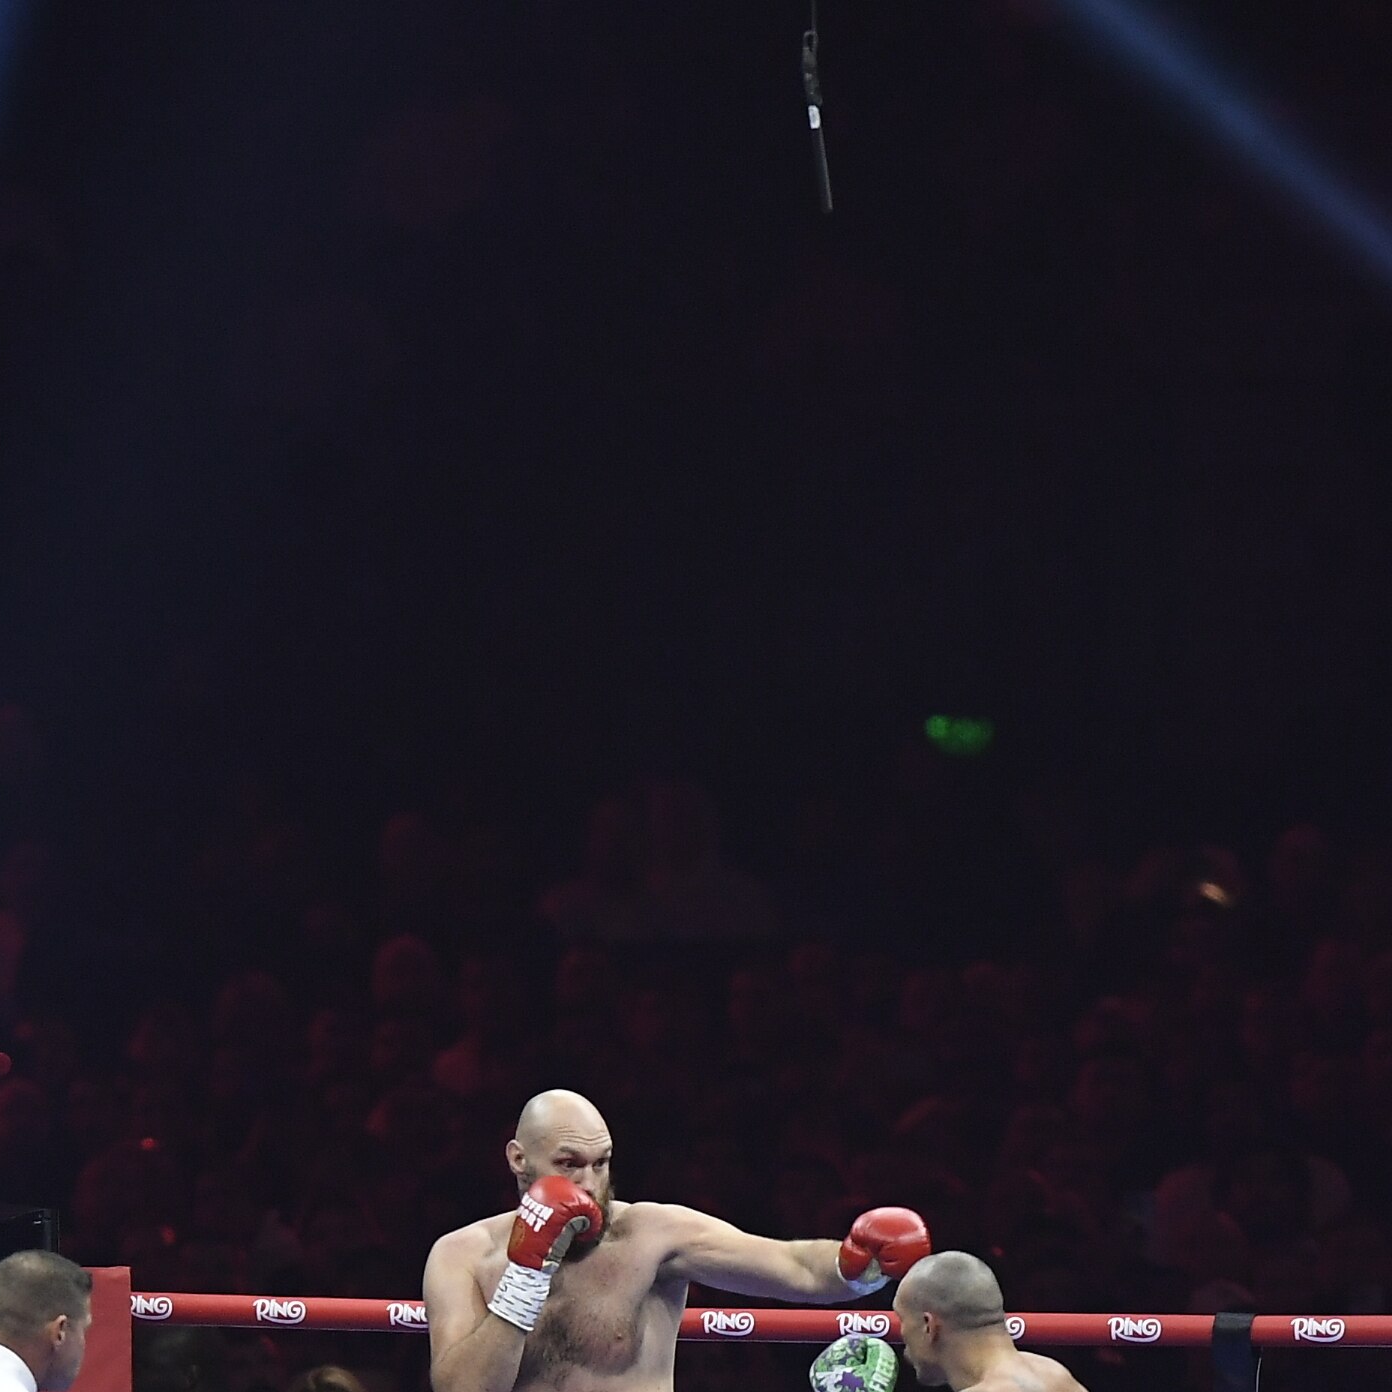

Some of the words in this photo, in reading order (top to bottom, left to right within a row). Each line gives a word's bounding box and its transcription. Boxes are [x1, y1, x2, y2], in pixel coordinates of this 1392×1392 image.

[130, 1296, 172, 1319] ING
[253, 1299, 307, 1324] RING
[387, 1303, 428, 1328] RIN
[700, 1311, 754, 1336] RING
[1108, 1316, 1162, 1343] RING
[1291, 1318, 1345, 1342] RING
